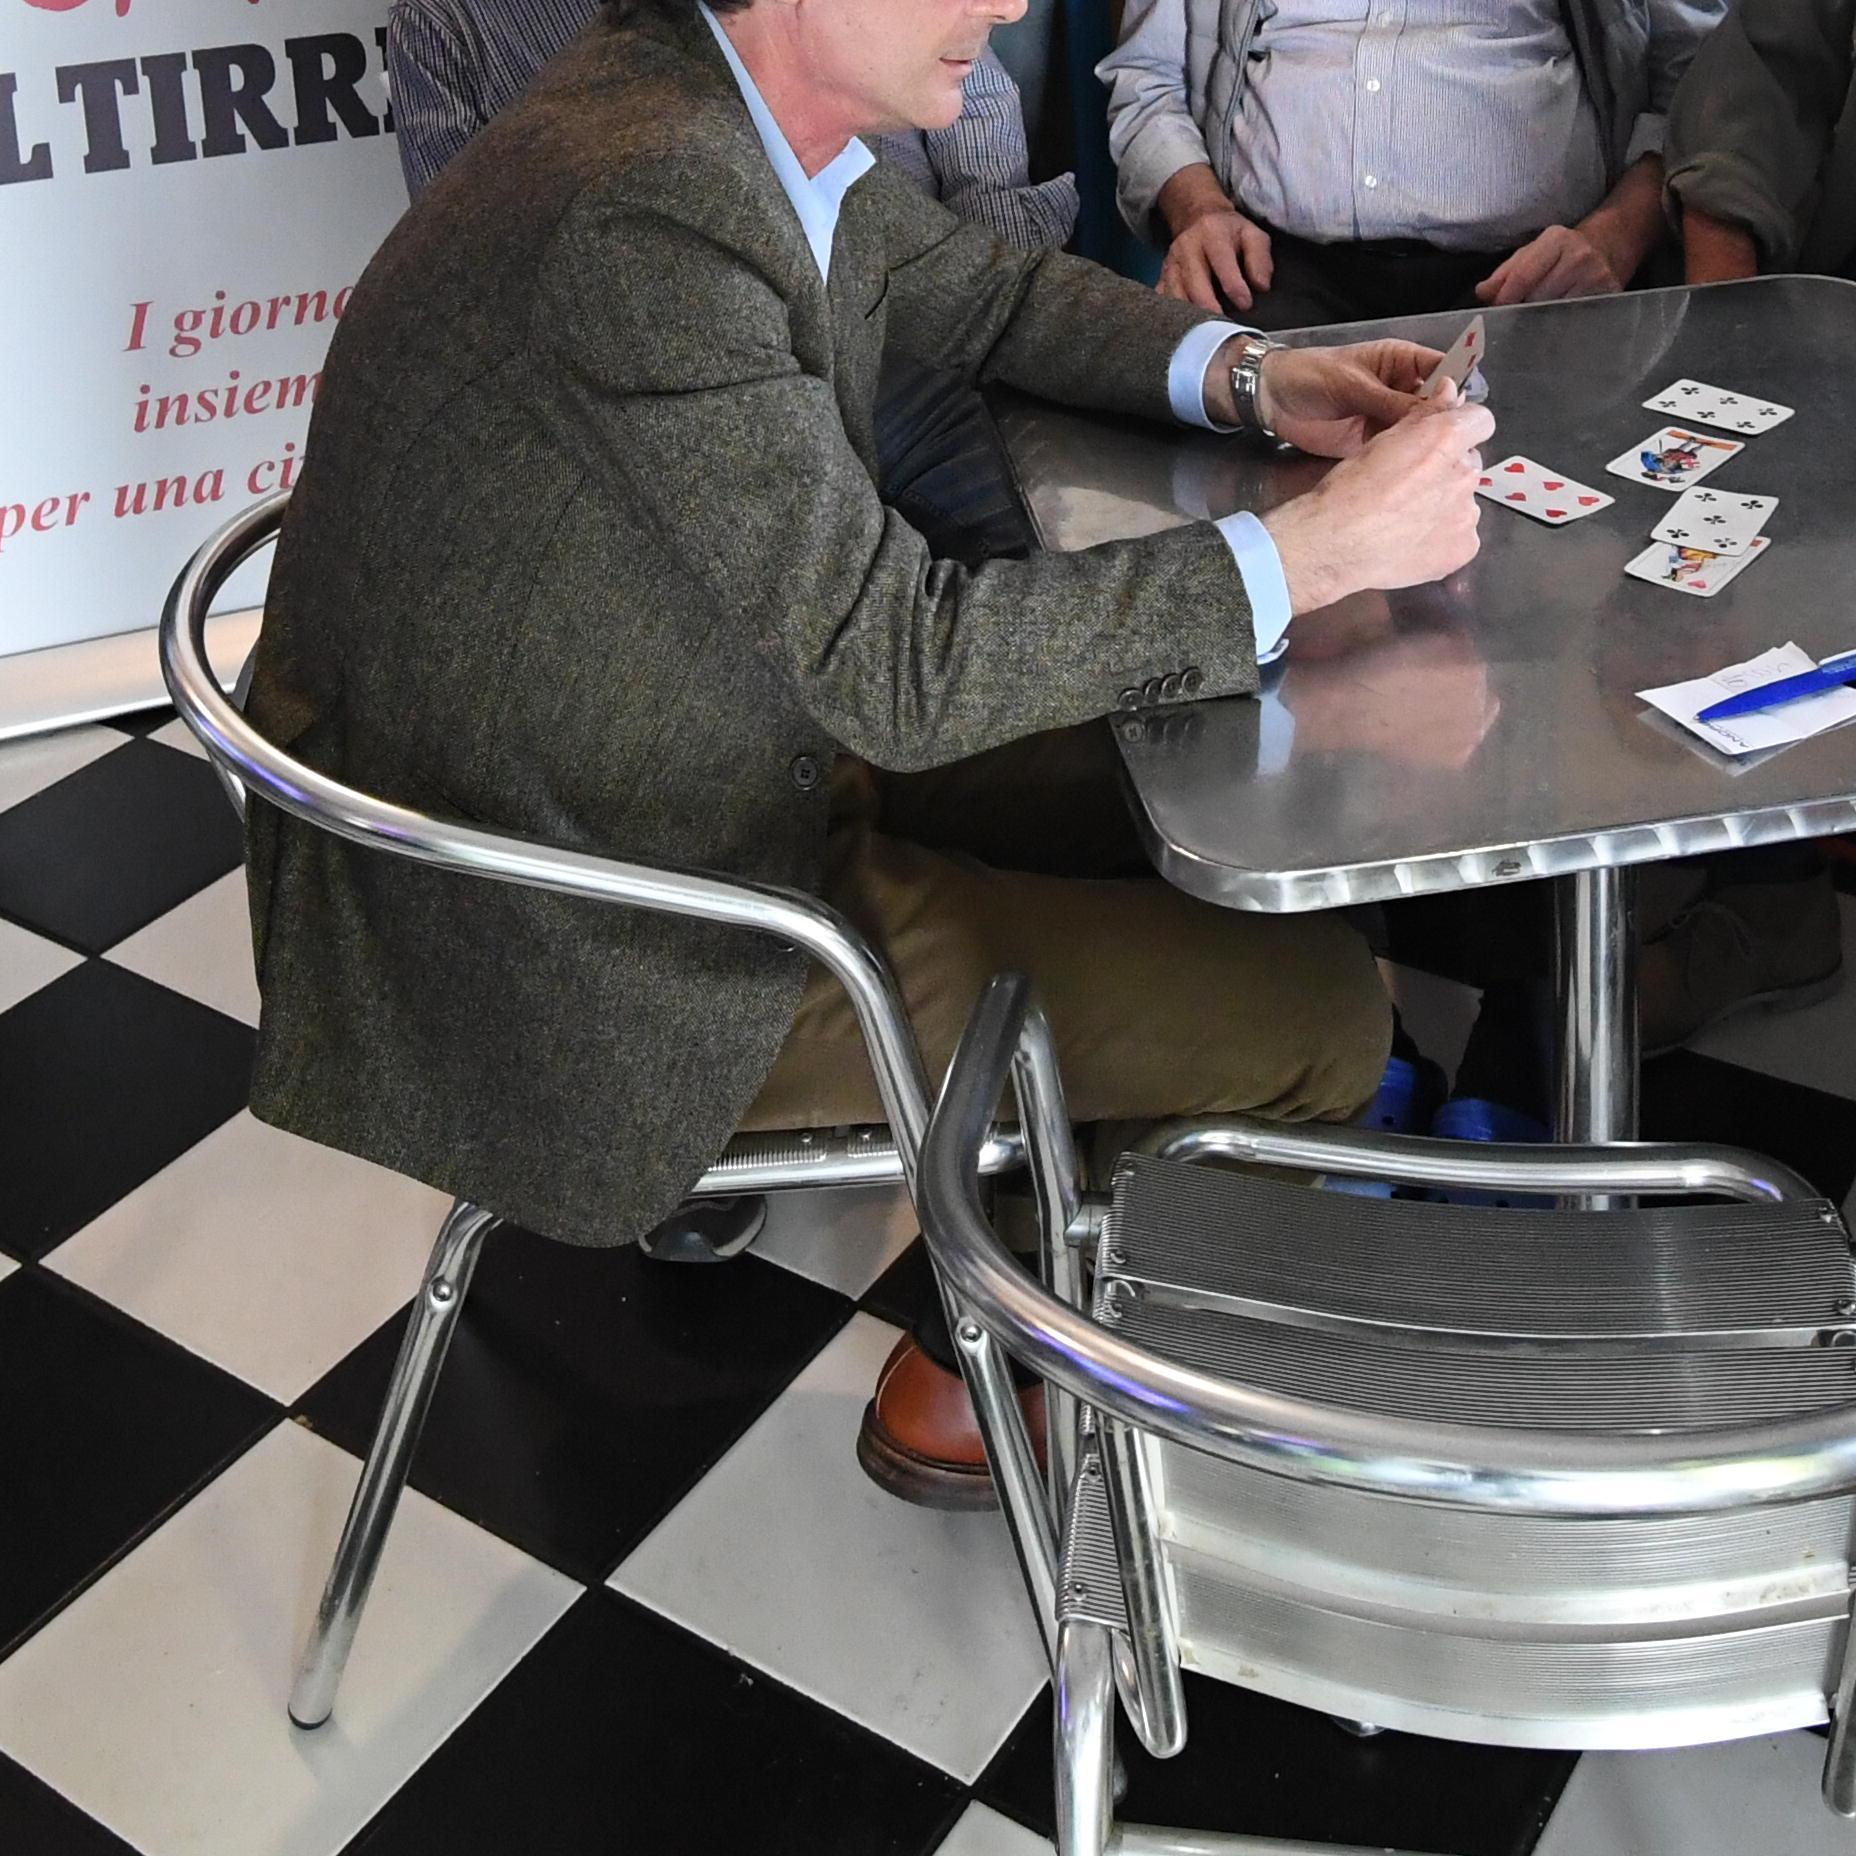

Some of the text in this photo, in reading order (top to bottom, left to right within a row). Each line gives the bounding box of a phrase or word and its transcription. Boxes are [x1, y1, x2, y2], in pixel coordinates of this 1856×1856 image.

[55, 26, 397, 174] TIRR
[122, 300, 154, 352] I
[113, 467, 225, 518] una
[247, 442, 308, 495] ci
